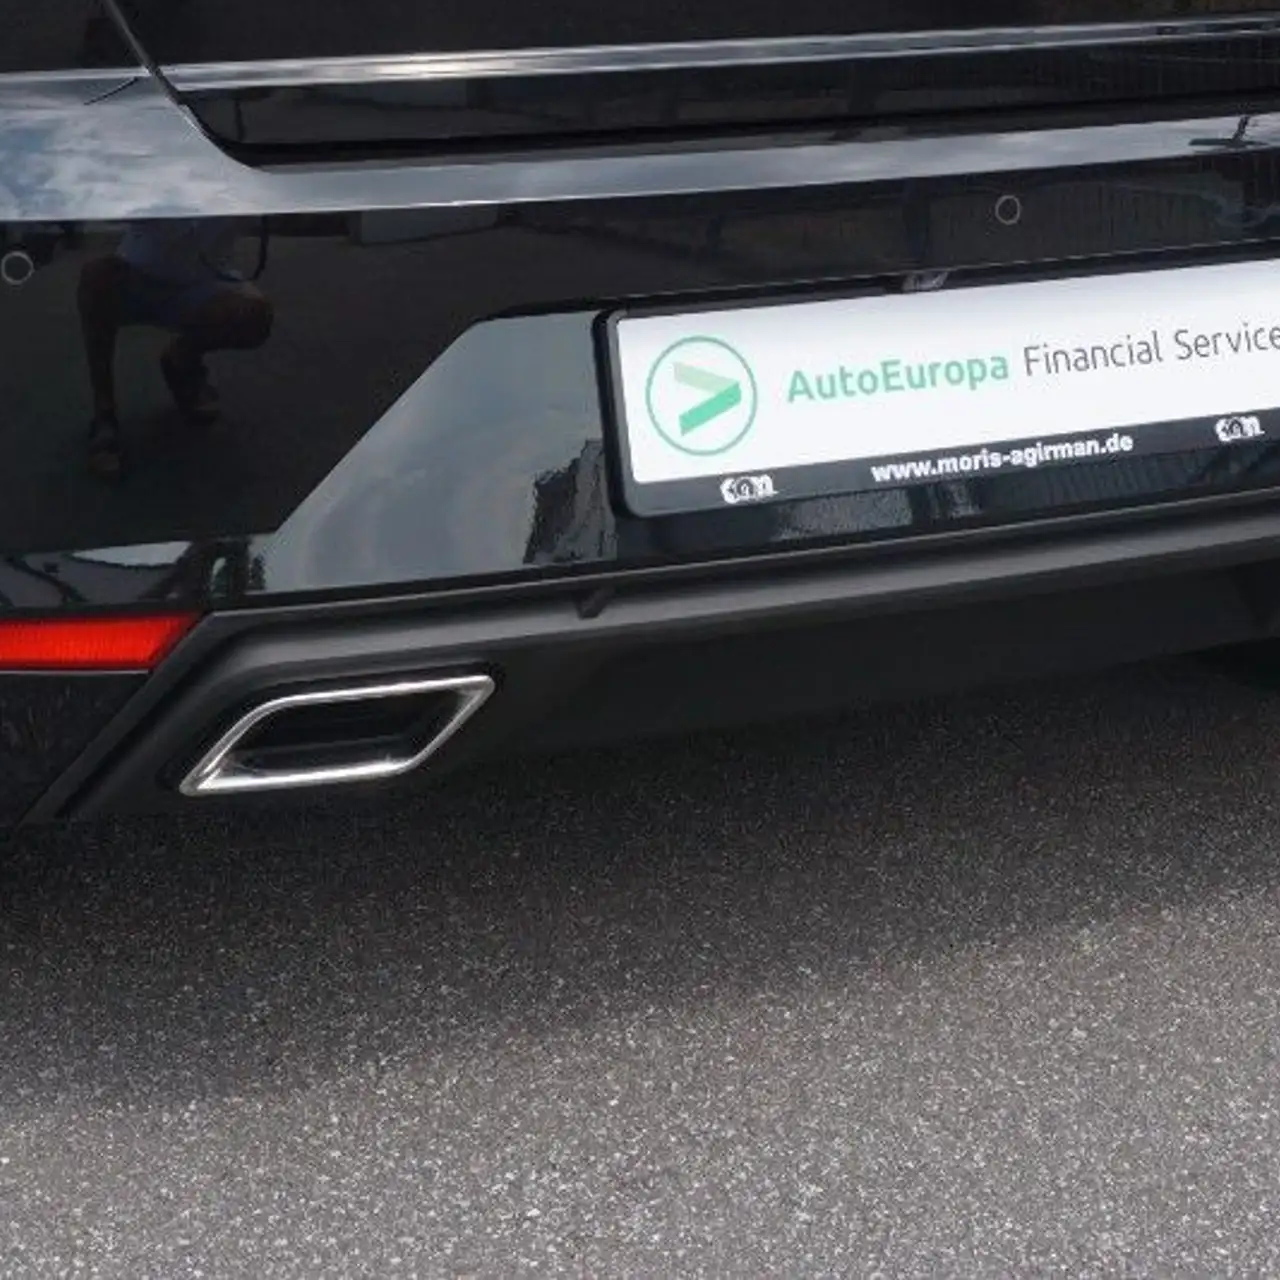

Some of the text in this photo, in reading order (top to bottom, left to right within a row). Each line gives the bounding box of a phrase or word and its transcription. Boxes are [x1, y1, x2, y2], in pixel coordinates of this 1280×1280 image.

[786, 349, 1010, 404] AutoEuropa
[1022, 329, 1164, 377] Financial
[870, 432, 1134, 482] www.moris-agirman.de
